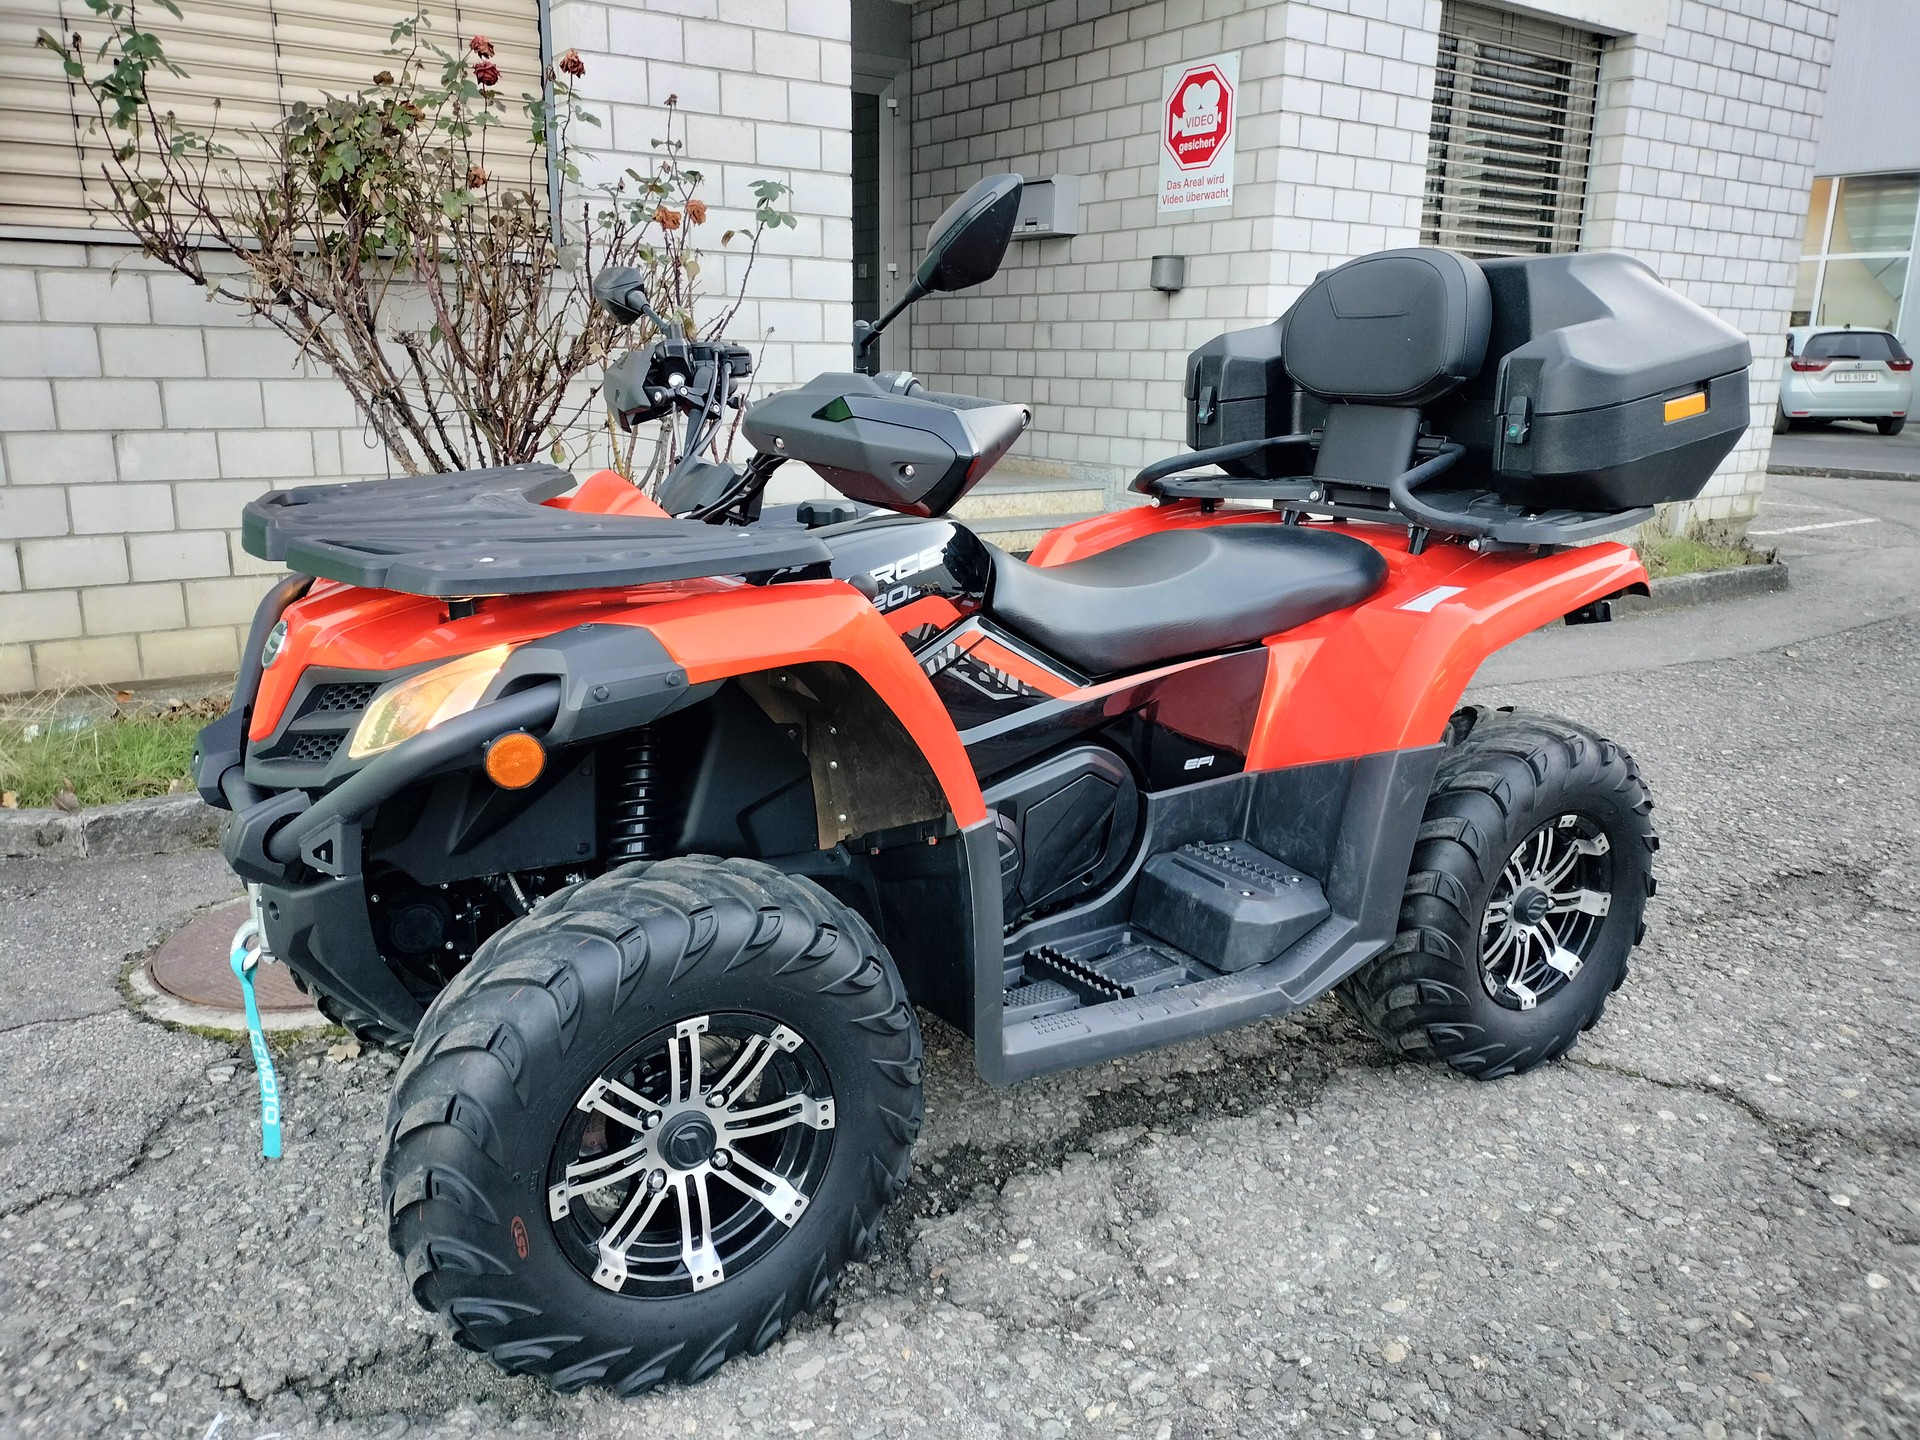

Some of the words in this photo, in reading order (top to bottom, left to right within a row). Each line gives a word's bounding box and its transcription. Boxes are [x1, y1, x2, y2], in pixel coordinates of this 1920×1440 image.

[1186, 113, 1214, 128] VIDEO
[1178, 136, 1215, 154] gesichert
[1166, 180, 1182, 190] Das
[1183, 176, 1205, 188] Areal
[1207, 173, 1225, 185] wird
[1162, 194, 1184, 205] Video
[1186, 188, 1229, 202] überwacht
[869, 545, 940, 585] RCE
[872, 585, 921, 612] 20L
[1184, 755, 1215, 770] EFI
[250, 1029, 279, 1125] CFMOTO
